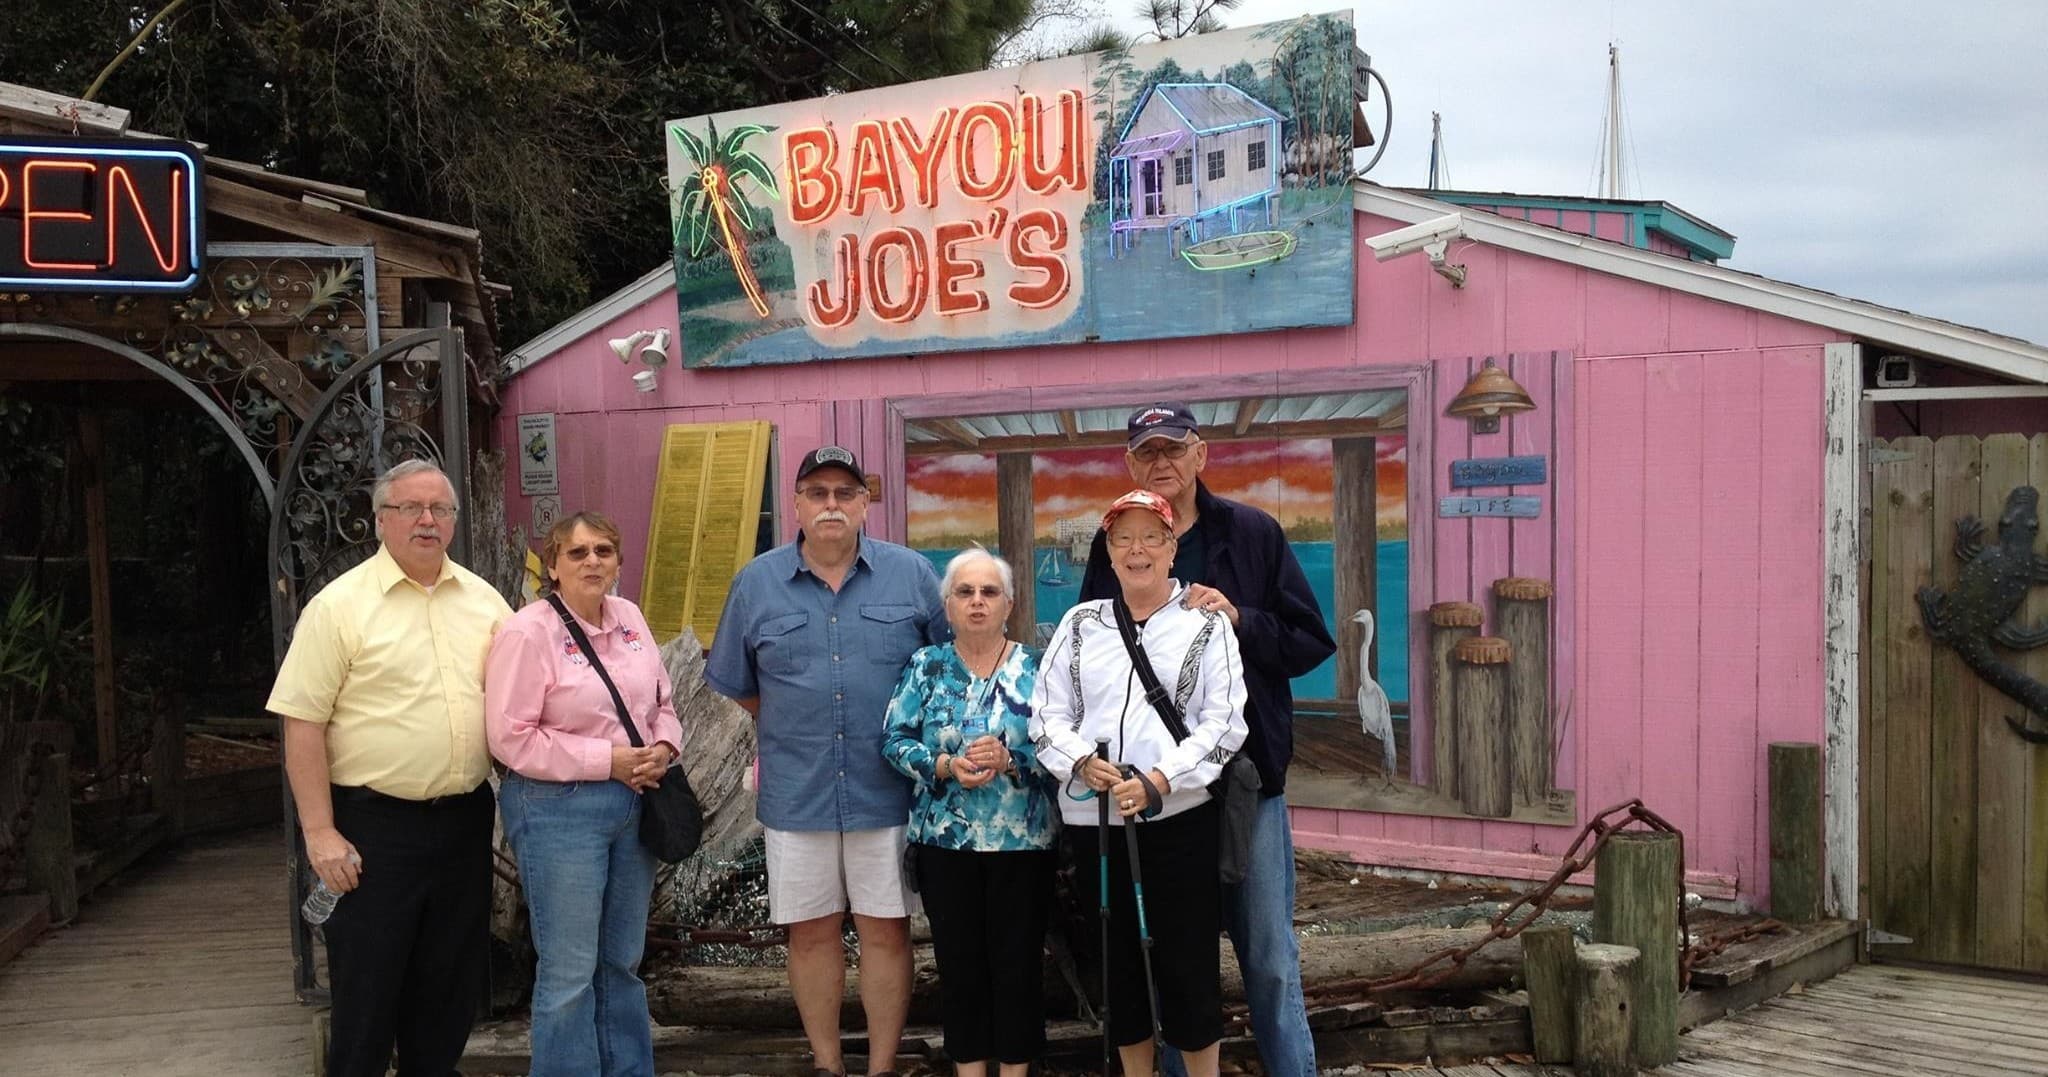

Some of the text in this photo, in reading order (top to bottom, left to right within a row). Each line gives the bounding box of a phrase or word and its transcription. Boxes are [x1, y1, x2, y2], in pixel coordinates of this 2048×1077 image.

[784, 90, 1087, 224] BAYOU
[808, 207, 1071, 328] JOE'S
[543, 511, 551, 522] R
[1459, 499, 1512, 513] LIFE
